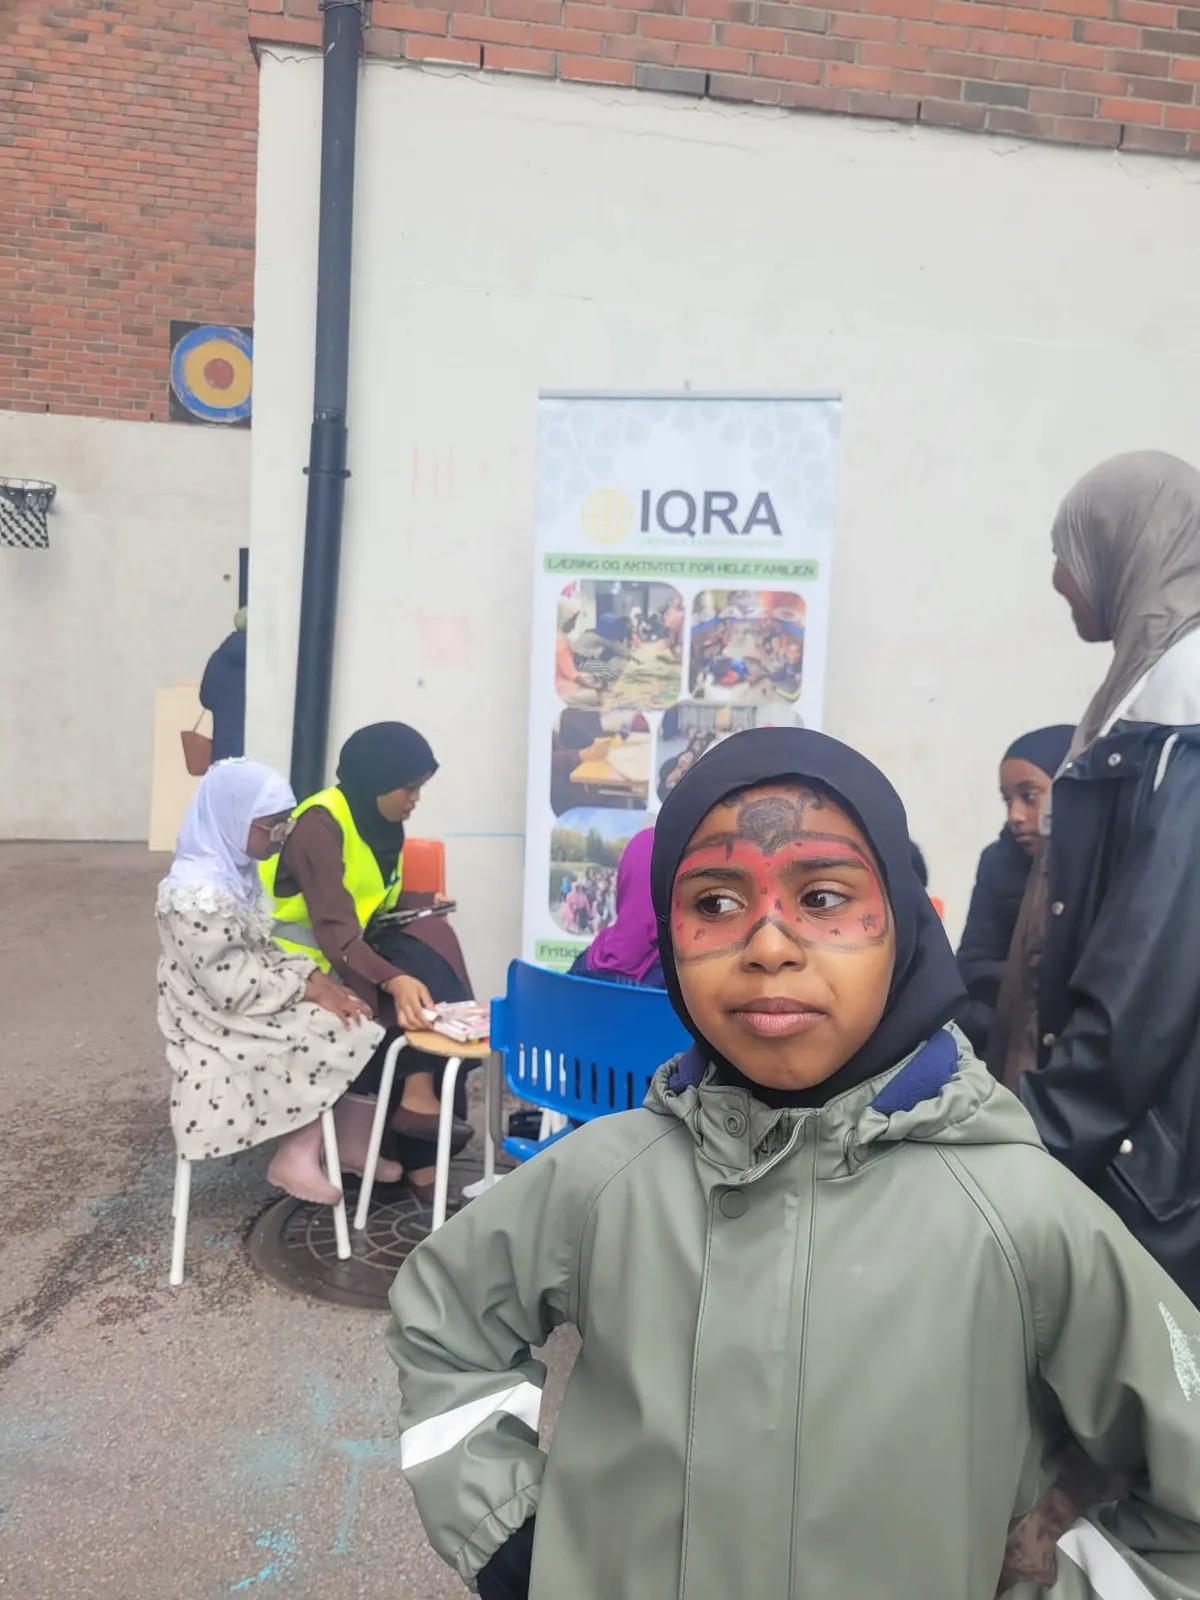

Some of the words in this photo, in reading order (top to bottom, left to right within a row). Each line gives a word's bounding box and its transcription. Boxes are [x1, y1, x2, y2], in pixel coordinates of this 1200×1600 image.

[641, 490, 782, 537] IQRA
[548, 558, 598, 570] LÆRING
[601, 560, 620, 571] OG
[623, 560, 685, 573] AKTIVITET
[688, 563, 714, 574] FOR
[717, 564, 750, 575] HELE
